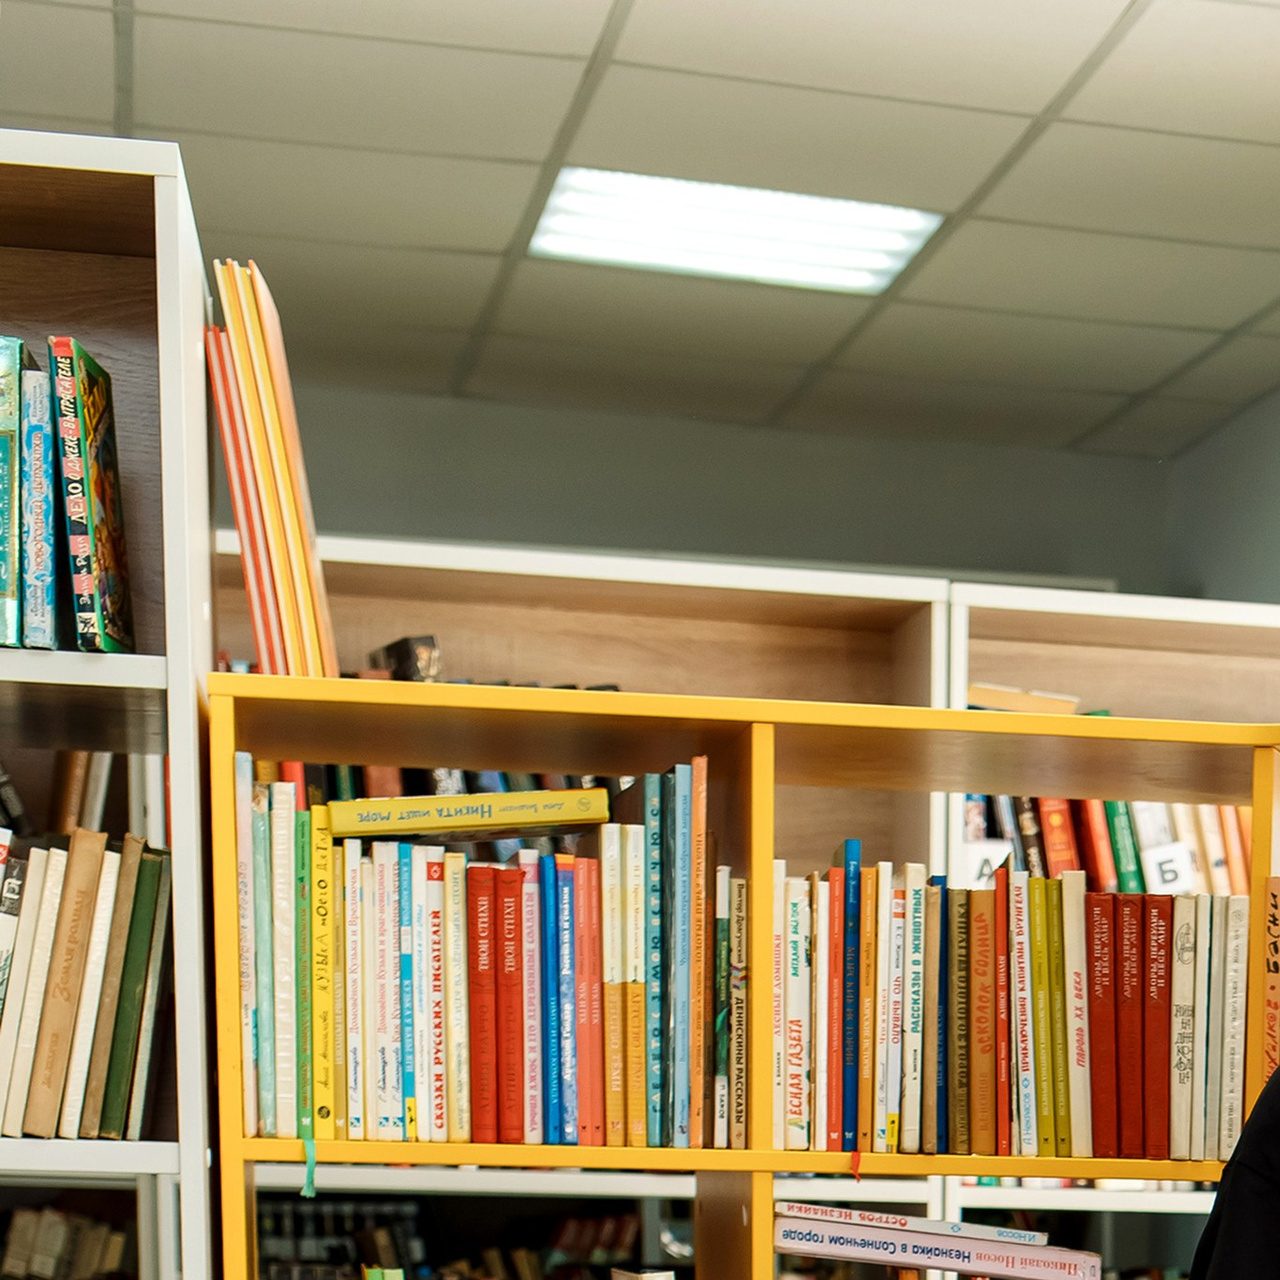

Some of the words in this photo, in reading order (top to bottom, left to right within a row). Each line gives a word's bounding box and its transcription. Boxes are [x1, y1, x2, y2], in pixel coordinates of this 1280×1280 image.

[66, 472, 81, 481] О
[68, 482, 88, 525] ДЕЛО
[477, 897, 489, 936] СТИХИ
[503, 898, 515, 937] СТИХИ
[736, 883, 744, 913] Виктор
[1013, 886, 1025, 936] ВРУНГЕЛЯ
[735, 915, 744, 963] Драгунский
[911, 888, 922, 953] ЖИВОТНЫХ
[349, 941, 360, 974] Кузька
[478, 940, 489, 971] ТВОИ
[504, 941, 516, 972] ТВОИ
[973, 913, 988, 976] СОЛНЦА
[893, 976, 901, 995] ЧТО
[1015, 942, 1027, 992] КАПИТАНА
[911, 971, 922, 1033] РАССКАЗЫ
[976, 984, 993, 1054] ОСКОЛОК
[734, 997, 743, 1065] ДЕНИСКИНЫ
[891, 1001, 900, 1044] БЫВАЛО
[1018, 996, 1030, 1072] ПРИКЛЮЧЕНИЯ
[787, 1019, 803, 1067] ГАЗЕТА
[735, 1068, 744, 1124] РАССКАЗЫ
[787, 1203, 853, 1221] НЕЗНАЙКИ
[857, 1212, 908, 1228] ОСТРОВ
[781, 1229, 824, 1245] городе
[827, 1235, 897, 1255] Солнечном
[900, 1244, 908, 1254] в
[910, 1244, 971, 1264] Незнайка
[974, 1252, 1016, 1269] Носов
[1018, 1257, 1079, 1276] Николай
